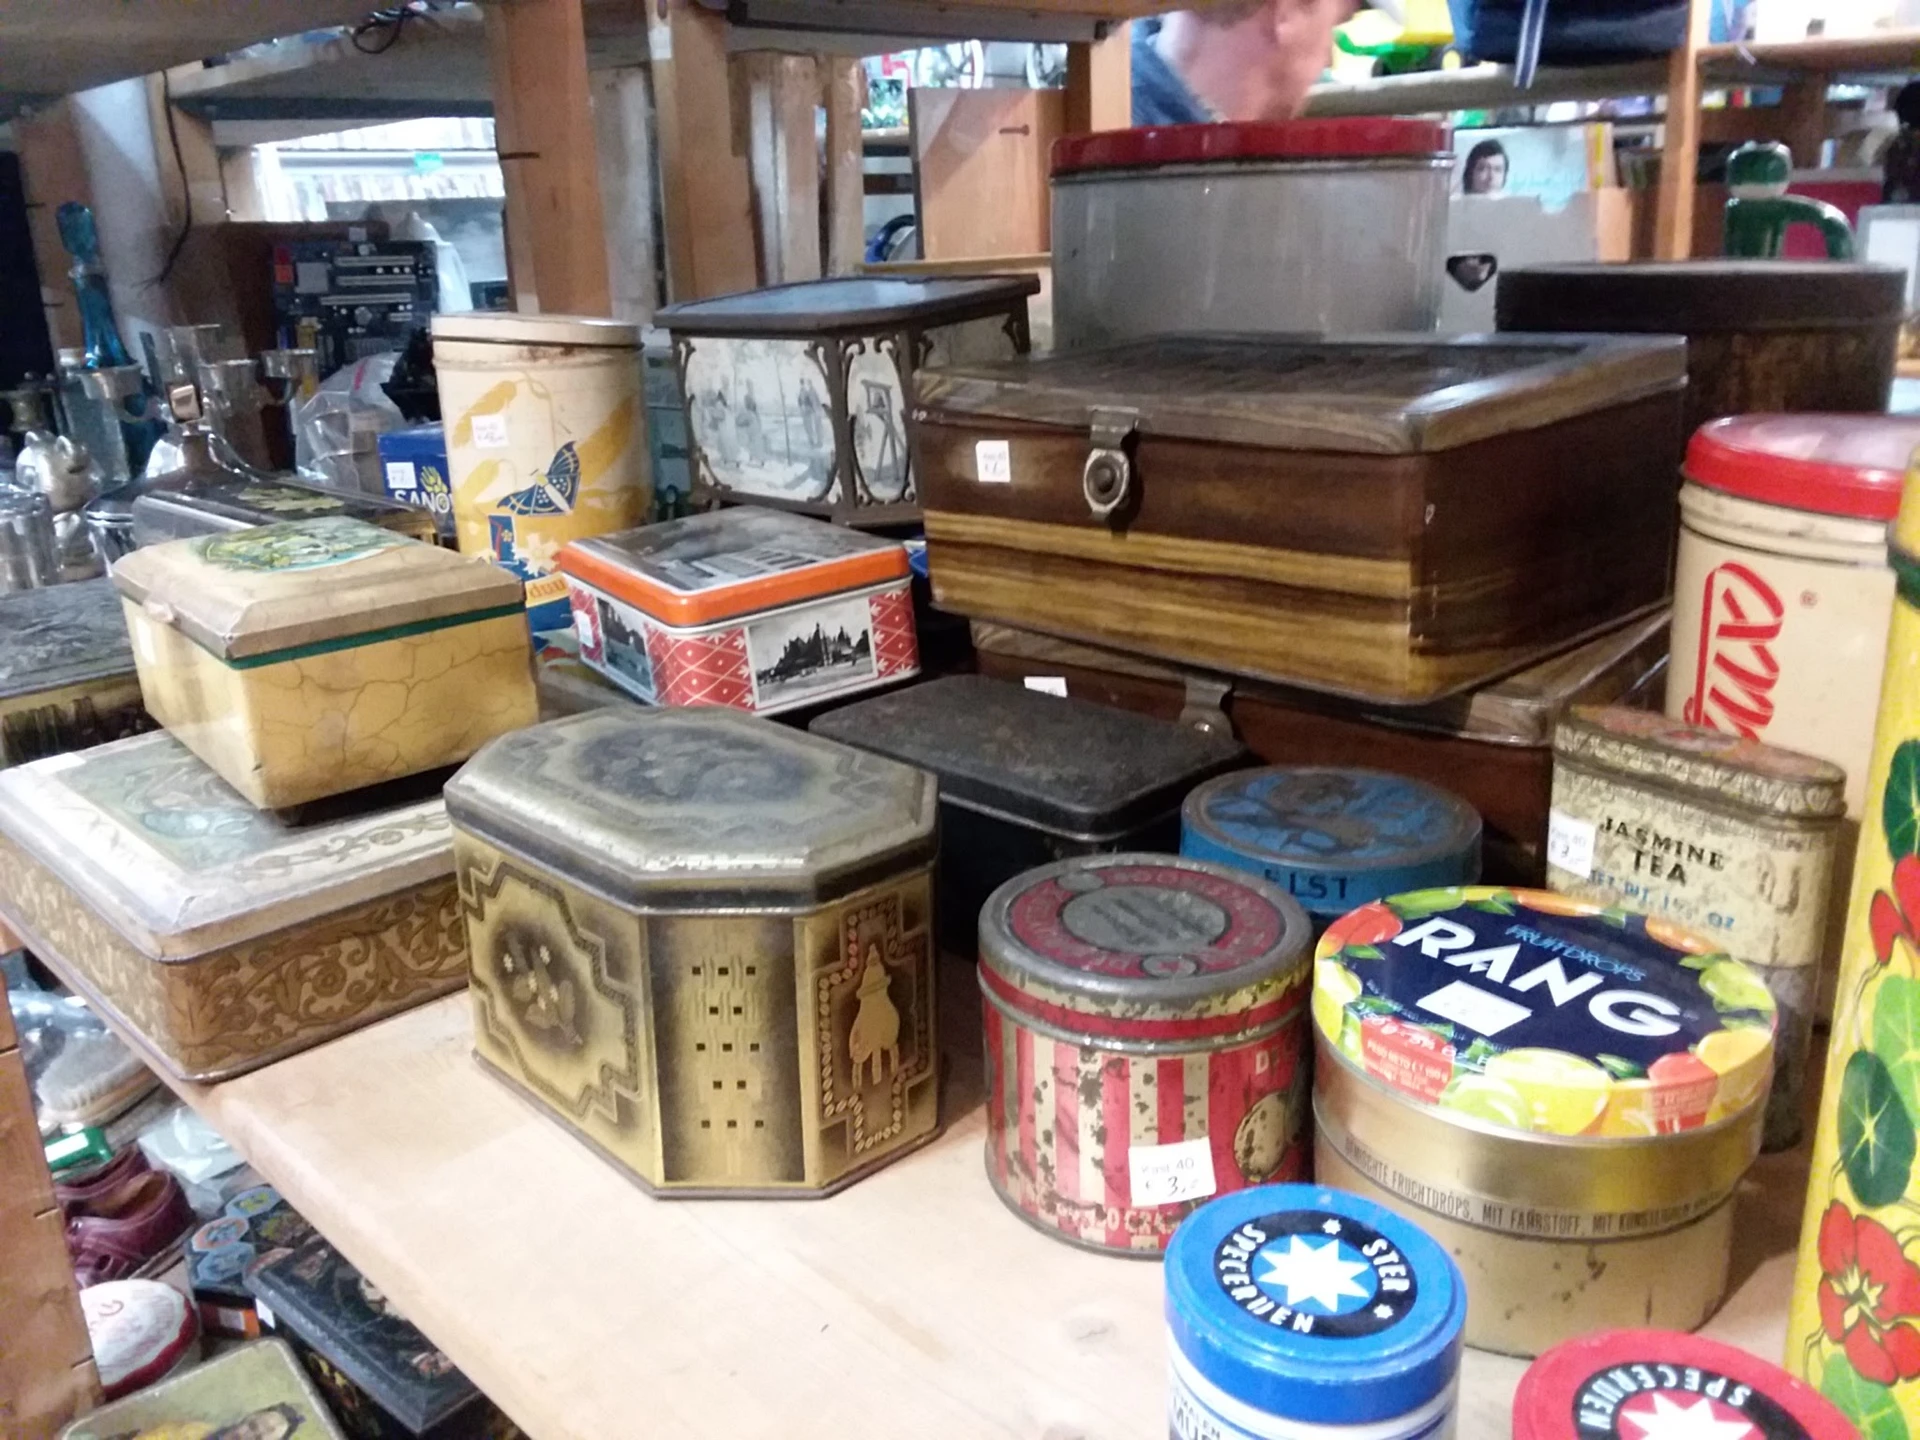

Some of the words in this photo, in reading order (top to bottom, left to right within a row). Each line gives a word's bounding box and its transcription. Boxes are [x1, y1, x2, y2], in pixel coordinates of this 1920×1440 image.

[394, 489, 453, 513] SANO
[1600, 816, 1725, 871] JASMINE
[1633, 850, 1687, 887] TEA
[1392, 916, 1682, 1037] RANG
[1482, 1203, 1503, 1223] MIT
[1362, 1238, 1410, 1293] STER
